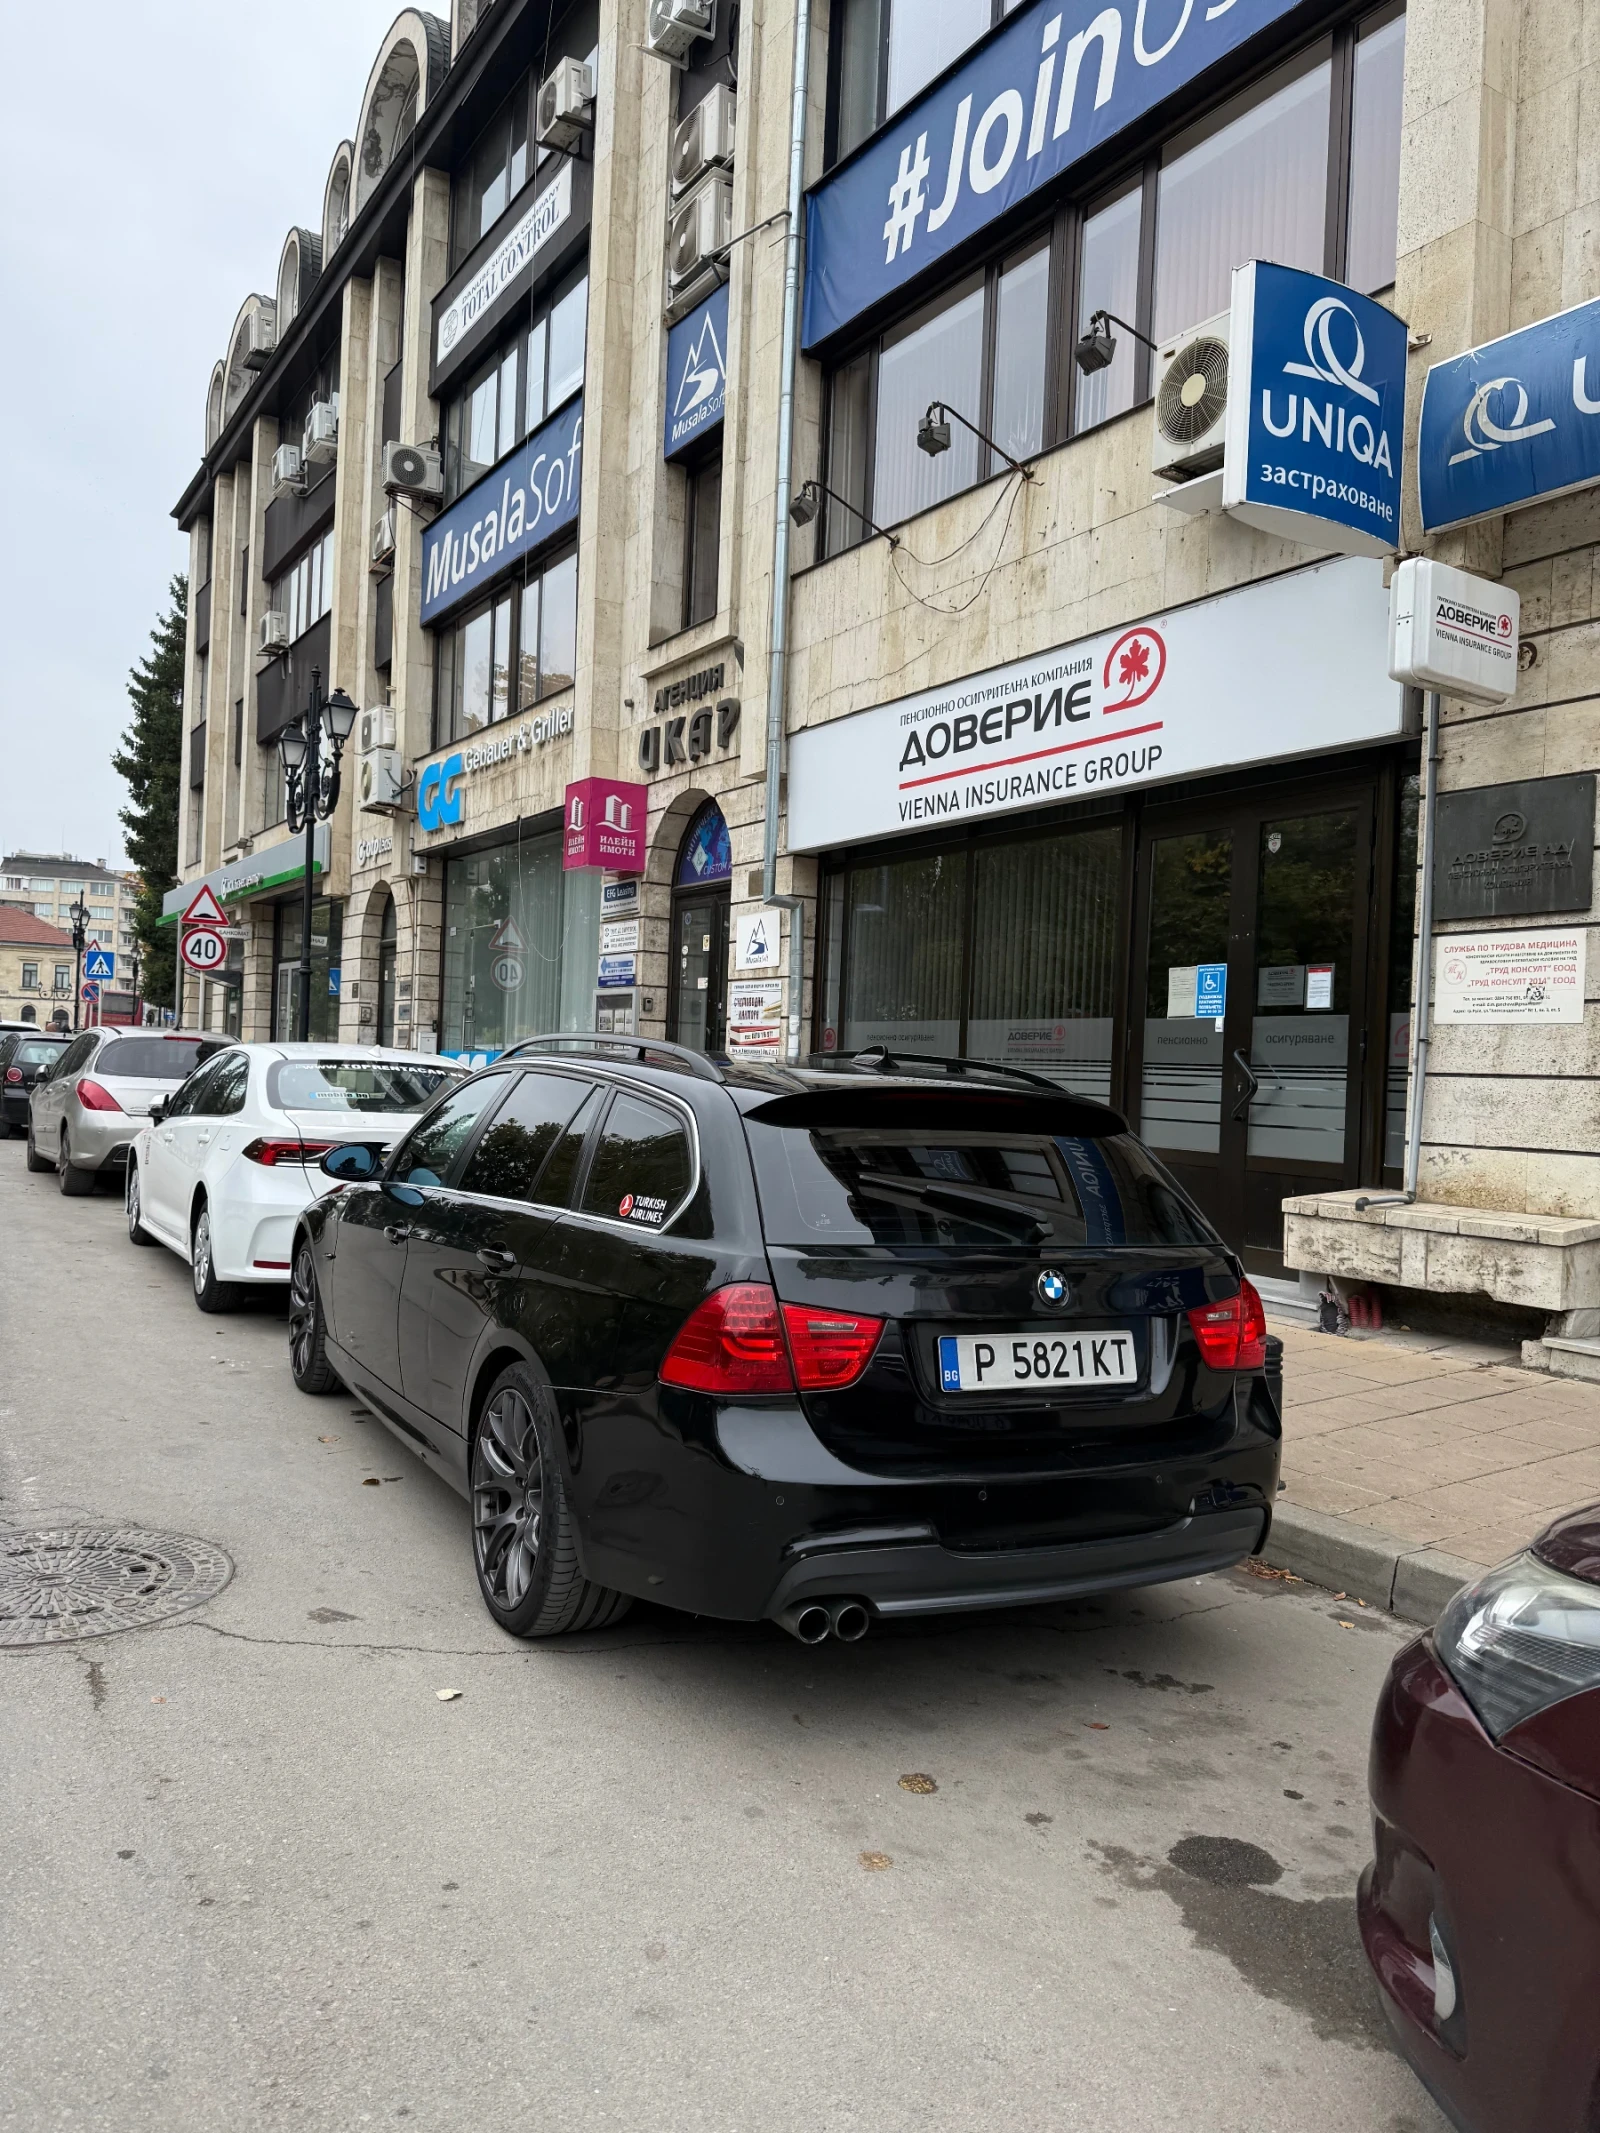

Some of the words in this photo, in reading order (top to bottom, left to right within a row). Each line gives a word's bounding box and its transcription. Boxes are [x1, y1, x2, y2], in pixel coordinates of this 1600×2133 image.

[883, 0, 1238, 265] #Join
[462, 270, 490, 304] DANUBE
[491, 234, 519, 272] SURVEY
[521, 182, 560, 234] COMPANY
[462, 273, 499, 327] TOTAL
[500, 200, 560, 283] CONTROL
[1262, 389, 1394, 479] UNIQA
[1260, 464, 1393, 523] застраховане
[1436, 604, 1496, 635] ДОВЕРИЕ
[1436, 628, 1458, 643] VIENNA
[1459, 635, 1491, 654] INSURANCE
[1493, 646, 1512, 660] GROUP
[654, 663, 725, 713] АГЕНЦИЯ
[900, 699, 955, 726] ПЕНСИОННО
[957, 677, 1029, 713] ОСИГУРИТЕЛНА
[1031, 656, 1093, 686] КОМПАНИЯ
[899, 679, 1092, 771] ДОВЕРИЕ
[464, 736, 515, 772] Gebauer
[517, 723, 528, 751] &
[531, 707, 574, 744] Griller
[899, 791, 960, 822] VIENNA
[966, 763, 1077, 809] INSURANCE
[1084, 745, 1163, 784] GROUP
[600, 835, 636, 848] ИЛЕЙН
[600, 845, 636, 857] ИМОТИ
[703, 852, 727, 866] CUSTOM
[1452, 846, 1537, 866] ДОВЕРИЕ
[1448, 868, 1498, 880] ПЕНСИОННО
[1501, 860, 1573, 875] ОСИГУРИТЕЛНА
[607, 889, 616, 899] EFG
[617, 885, 635, 898] Leasing
[1484, 878, 1532, 889] КОМПАНИЯ
[190, 938, 217, 960] 40
[1444, 944, 1476, 954] СЛУЖБА
[1477, 944, 1489, 952] ПО
[1491, 942, 1526, 953] ТРУДОВА
[1528, 940, 1577, 950] МЕДИЦИНА
[1553, 964, 1576, 972] ЕООД
[1491, 978, 1526, 986] КОНСУЛТ
[1553, 977, 1576, 985] ЕООД
[1007, 1031, 1052, 1041] ДОВЕРИЕ
[1157, 1036, 1208, 1045] пенсионно
[1265, 1033, 1336, 1046] осигуряване
[635, 1195, 667, 1210] TURKISH
[629, 1208, 664, 1223] AIRLINES
[975, 1343, 995, 1382] P
[944, 1370, 958, 1382] BG
